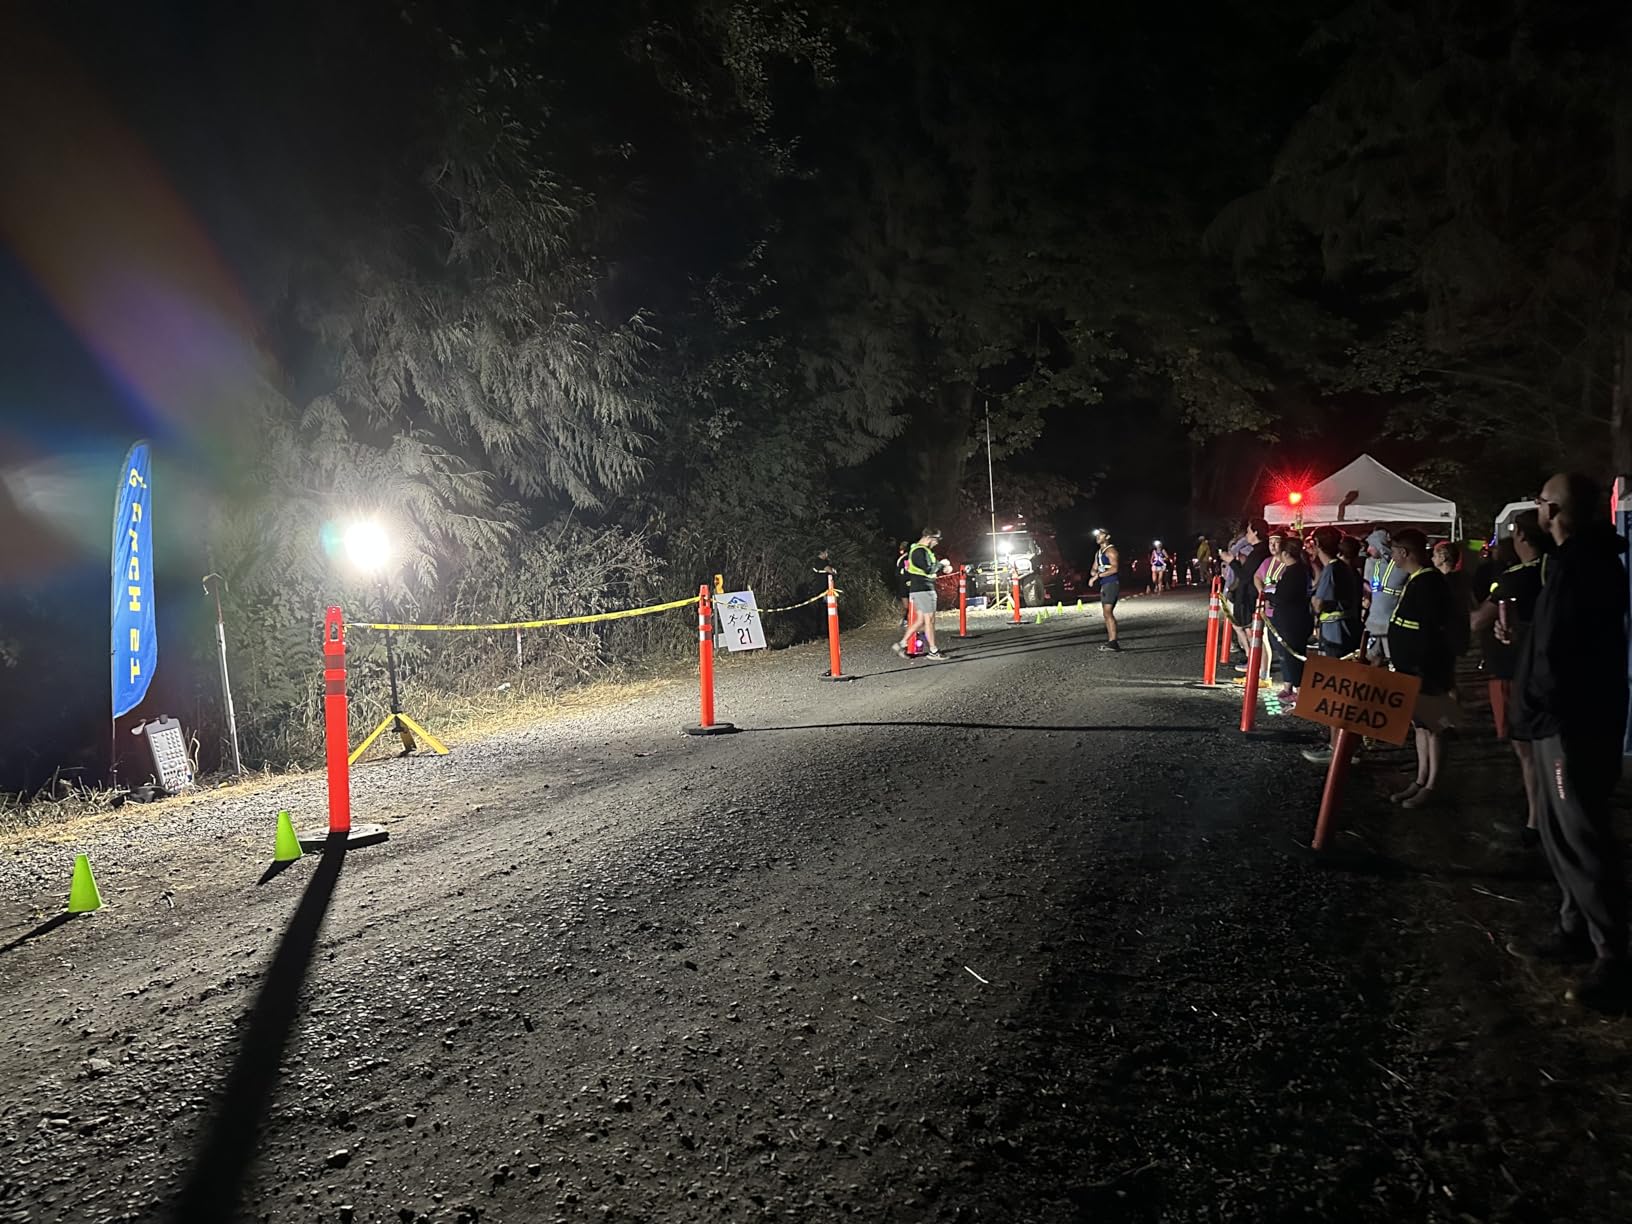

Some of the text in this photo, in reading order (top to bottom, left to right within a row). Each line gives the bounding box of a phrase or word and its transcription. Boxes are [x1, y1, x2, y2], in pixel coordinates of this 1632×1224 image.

[737, 627, 753, 645] 21
[1311, 671, 1405, 708] PARKING
[1314, 697, 1388, 729] AHEAD
